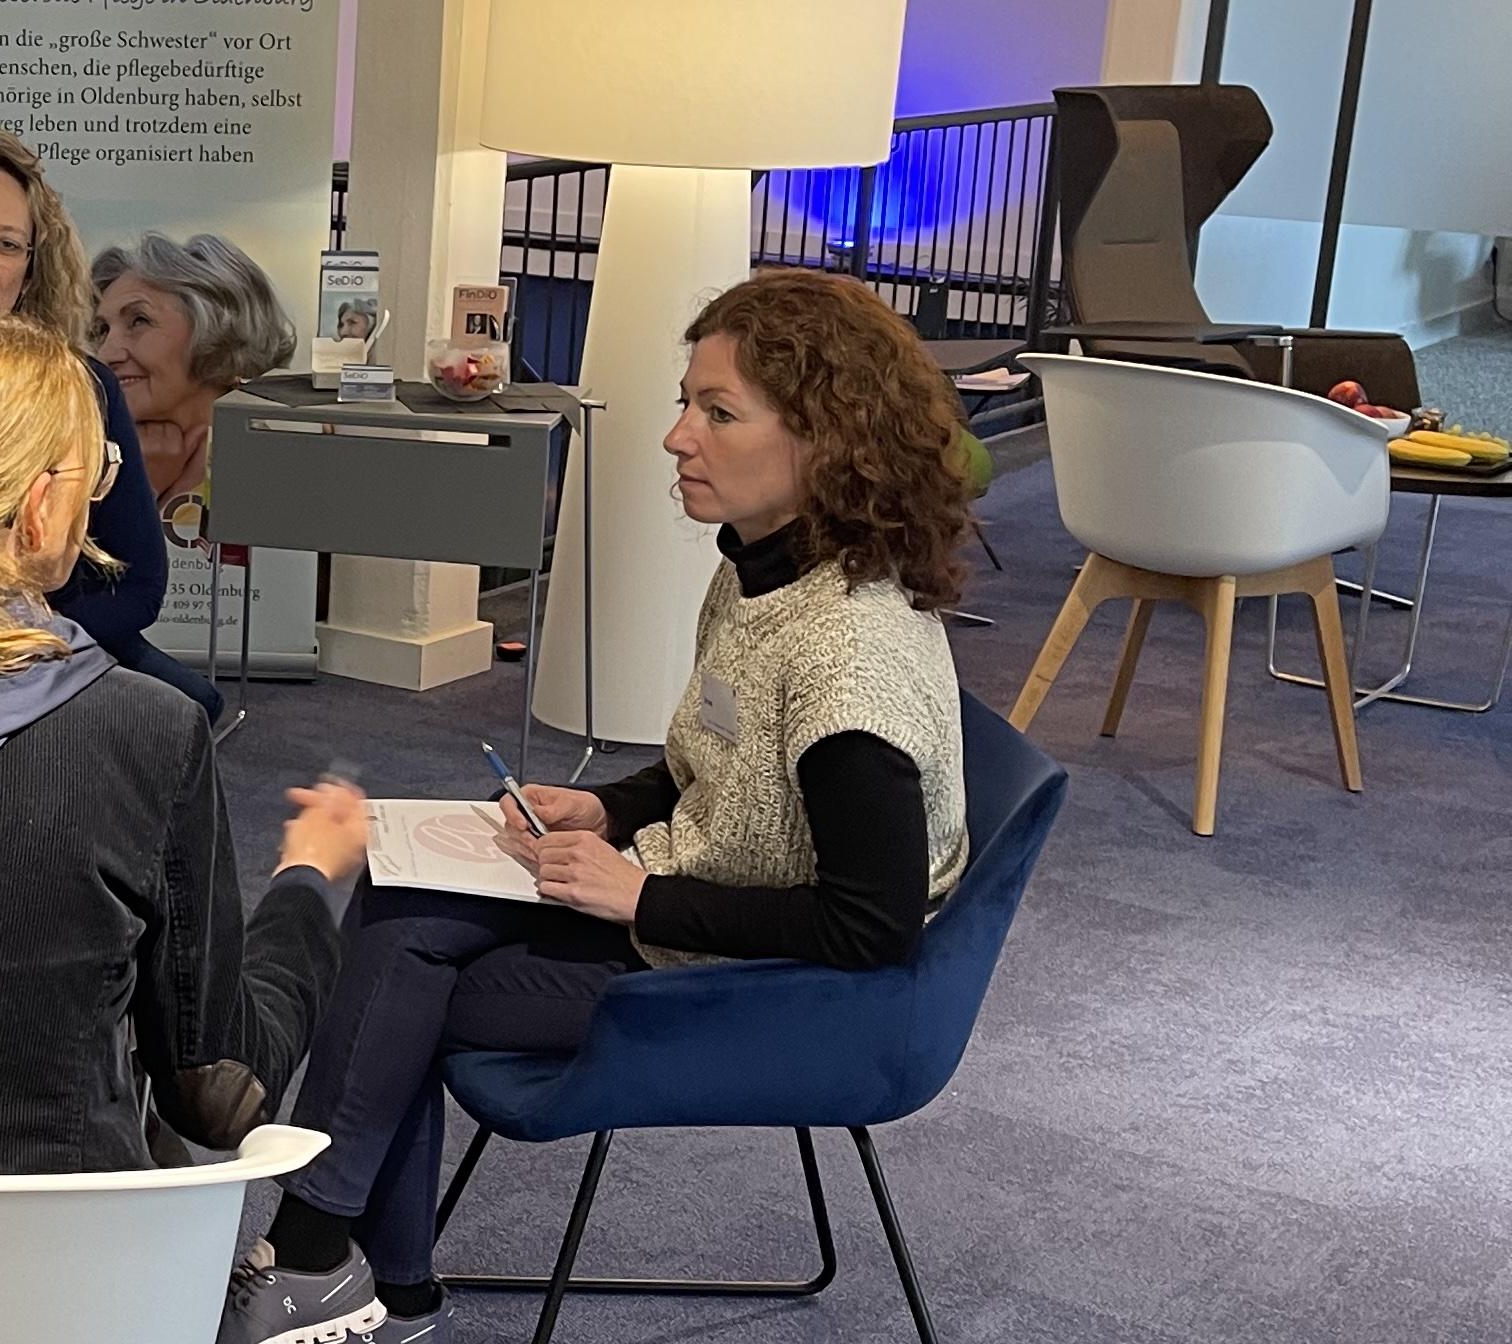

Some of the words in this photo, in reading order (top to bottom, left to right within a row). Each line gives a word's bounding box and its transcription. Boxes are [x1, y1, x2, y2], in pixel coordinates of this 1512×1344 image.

[16, 28, 44, 47] die
[223, 35, 253, 50] vor
[259, 32, 292, 50] Ort
[83, 58, 111, 76] die
[116, 58, 265, 84] pflegebedürftige
[57, 88, 75, 104] in
[80, 86, 180, 111] Oldenburg
[185, 87, 246, 109] haben,
[251, 89, 302, 107] selbst
[29, 114, 78, 132] leben
[84, 115, 119, 133] und
[126, 116, 208, 134] trotzdem
[213, 118, 252, 135] eine
[38, 142, 90, 165] Pflege
[95, 144, 192, 166] organisiert
[199, 144, 254, 163] haben
[189, 583, 261, 601] Oldnbrg
